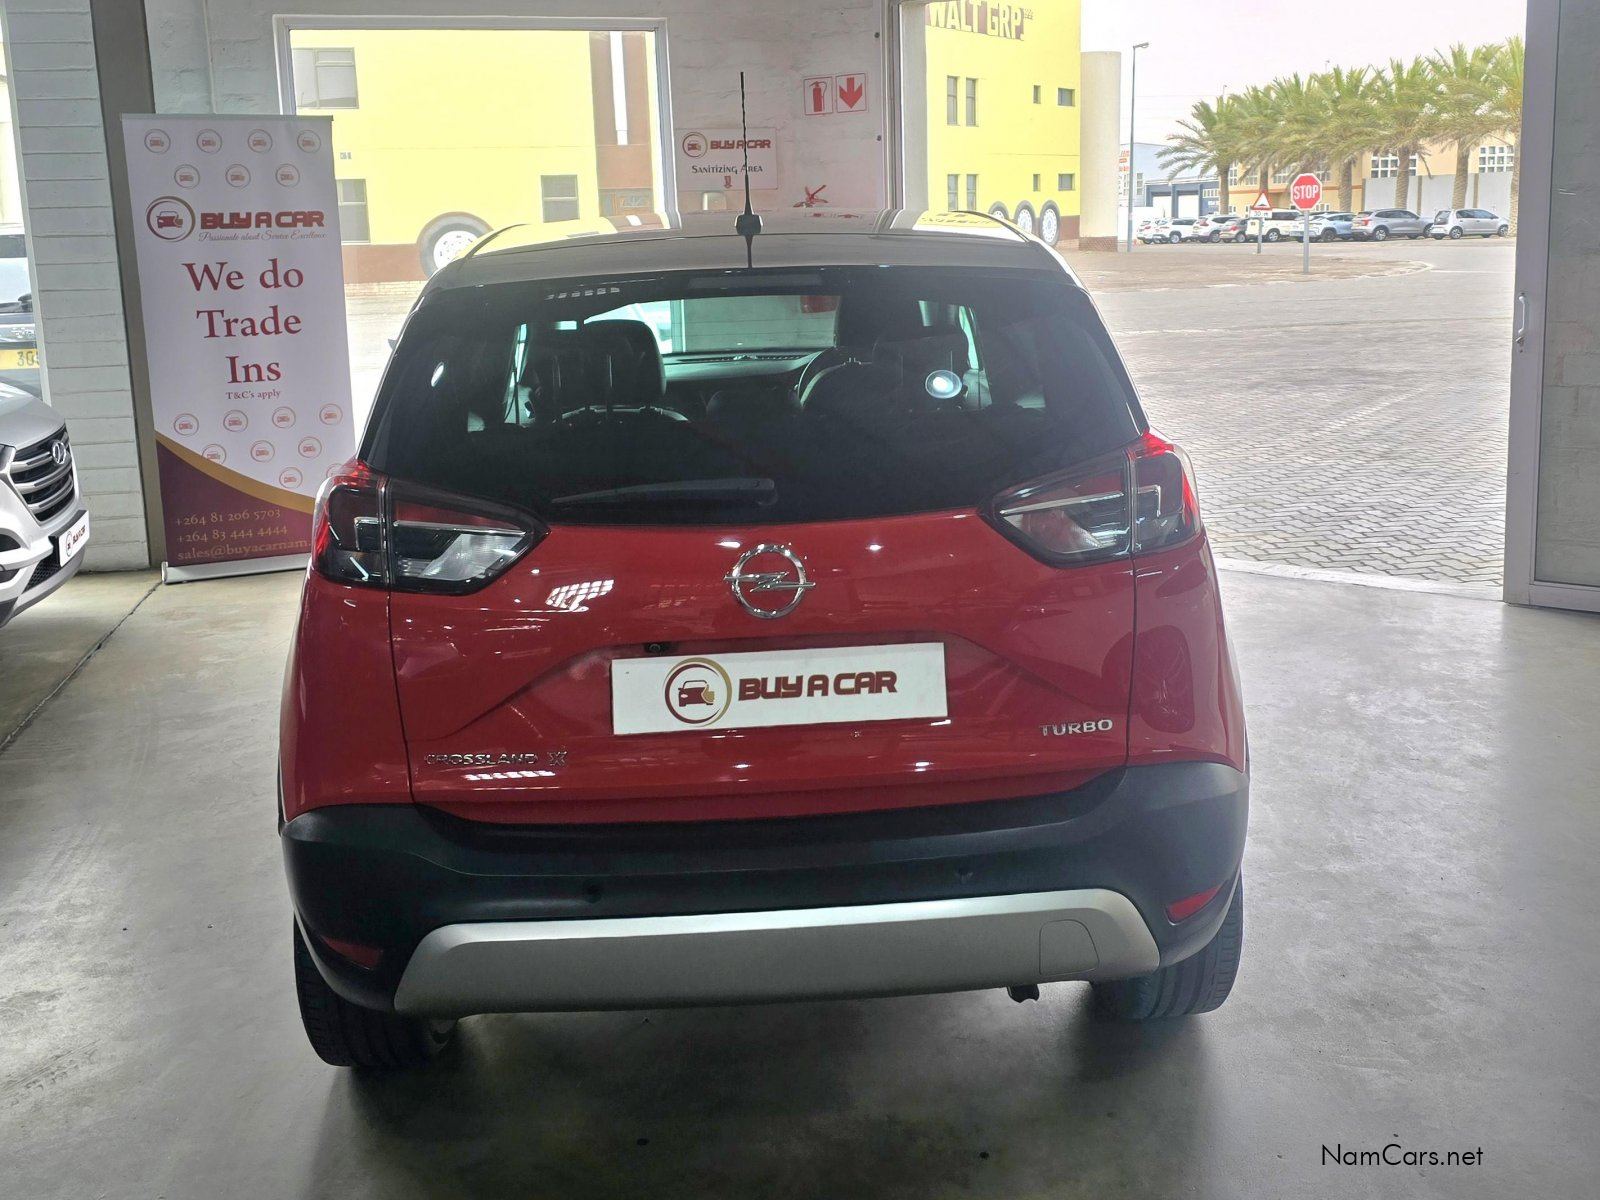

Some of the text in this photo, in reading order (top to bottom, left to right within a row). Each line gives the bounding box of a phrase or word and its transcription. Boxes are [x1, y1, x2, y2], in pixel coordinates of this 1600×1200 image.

[710, 139, 772, 150] BUY A CAR
[1293, 184, 1319, 200] STOP
[200, 210, 325, 230] BUY A CAR
[181, 257, 305, 292] We do
[196, 304, 302, 339] Trade
[225, 355, 282, 384] Ins
[225, 388, 282, 400] T&C's apply
[176, 508, 281, 526] +264 81 206 5703
[177, 524, 288, 543] +264 83 444 4444
[738, 670, 898, 702] BUY A CAR
[1039, 719, 1113, 737] TURBO
[424, 750, 568, 767] CROSSLAND X
